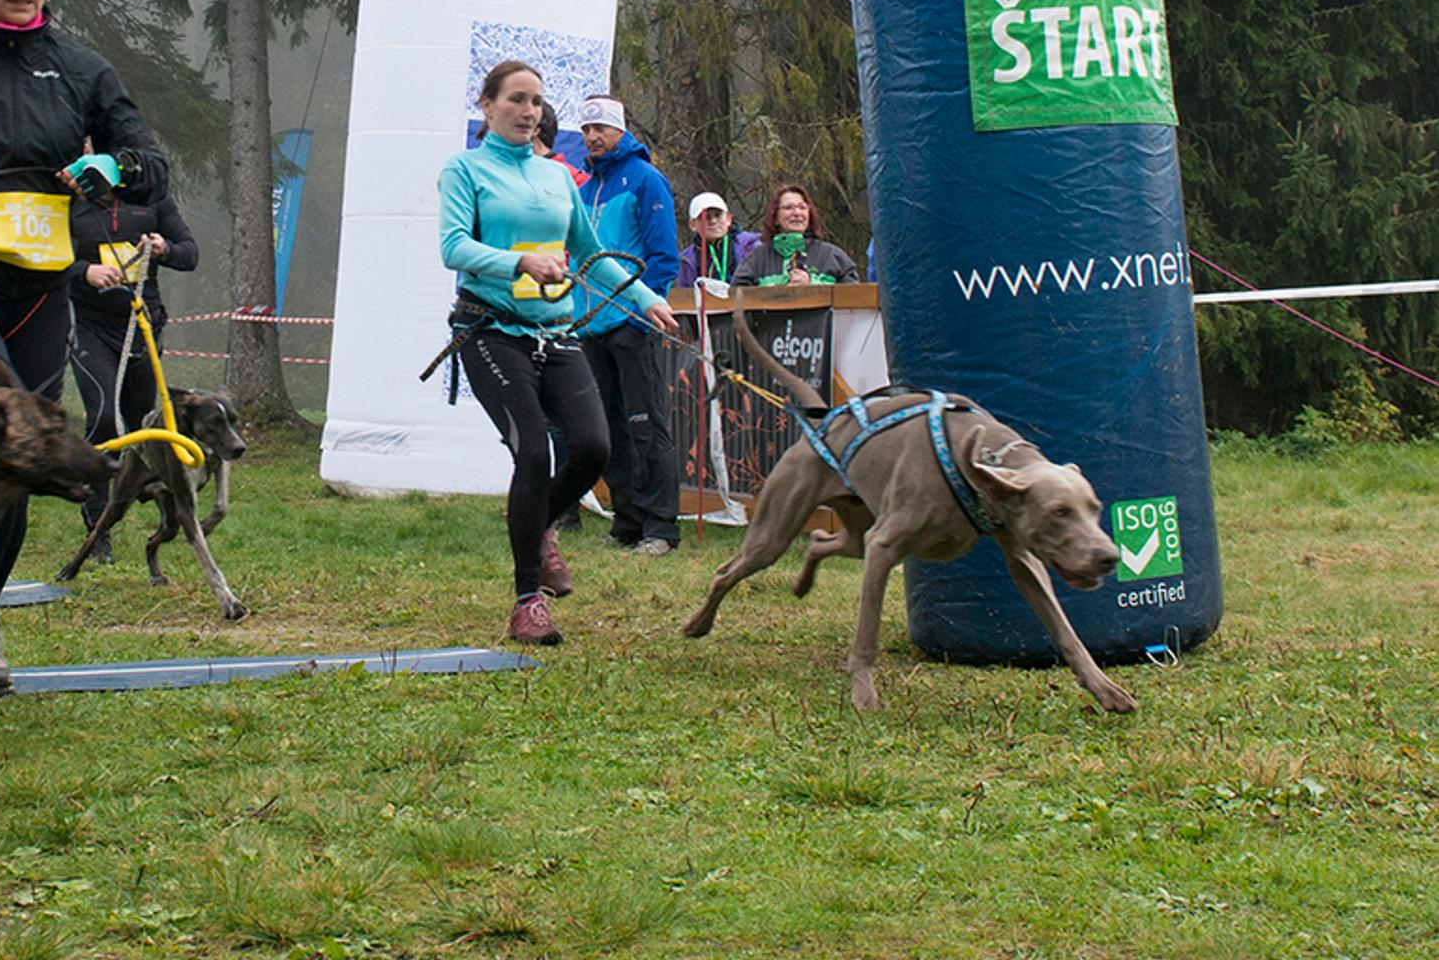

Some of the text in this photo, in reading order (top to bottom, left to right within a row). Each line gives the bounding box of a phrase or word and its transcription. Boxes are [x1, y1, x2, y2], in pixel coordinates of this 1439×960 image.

[10, 214, 51, 238] 106
[1117, 503, 1158, 530] ISO
[1159, 501, 1180, 562] 9001
[1117, 580, 1186, 608] certified
